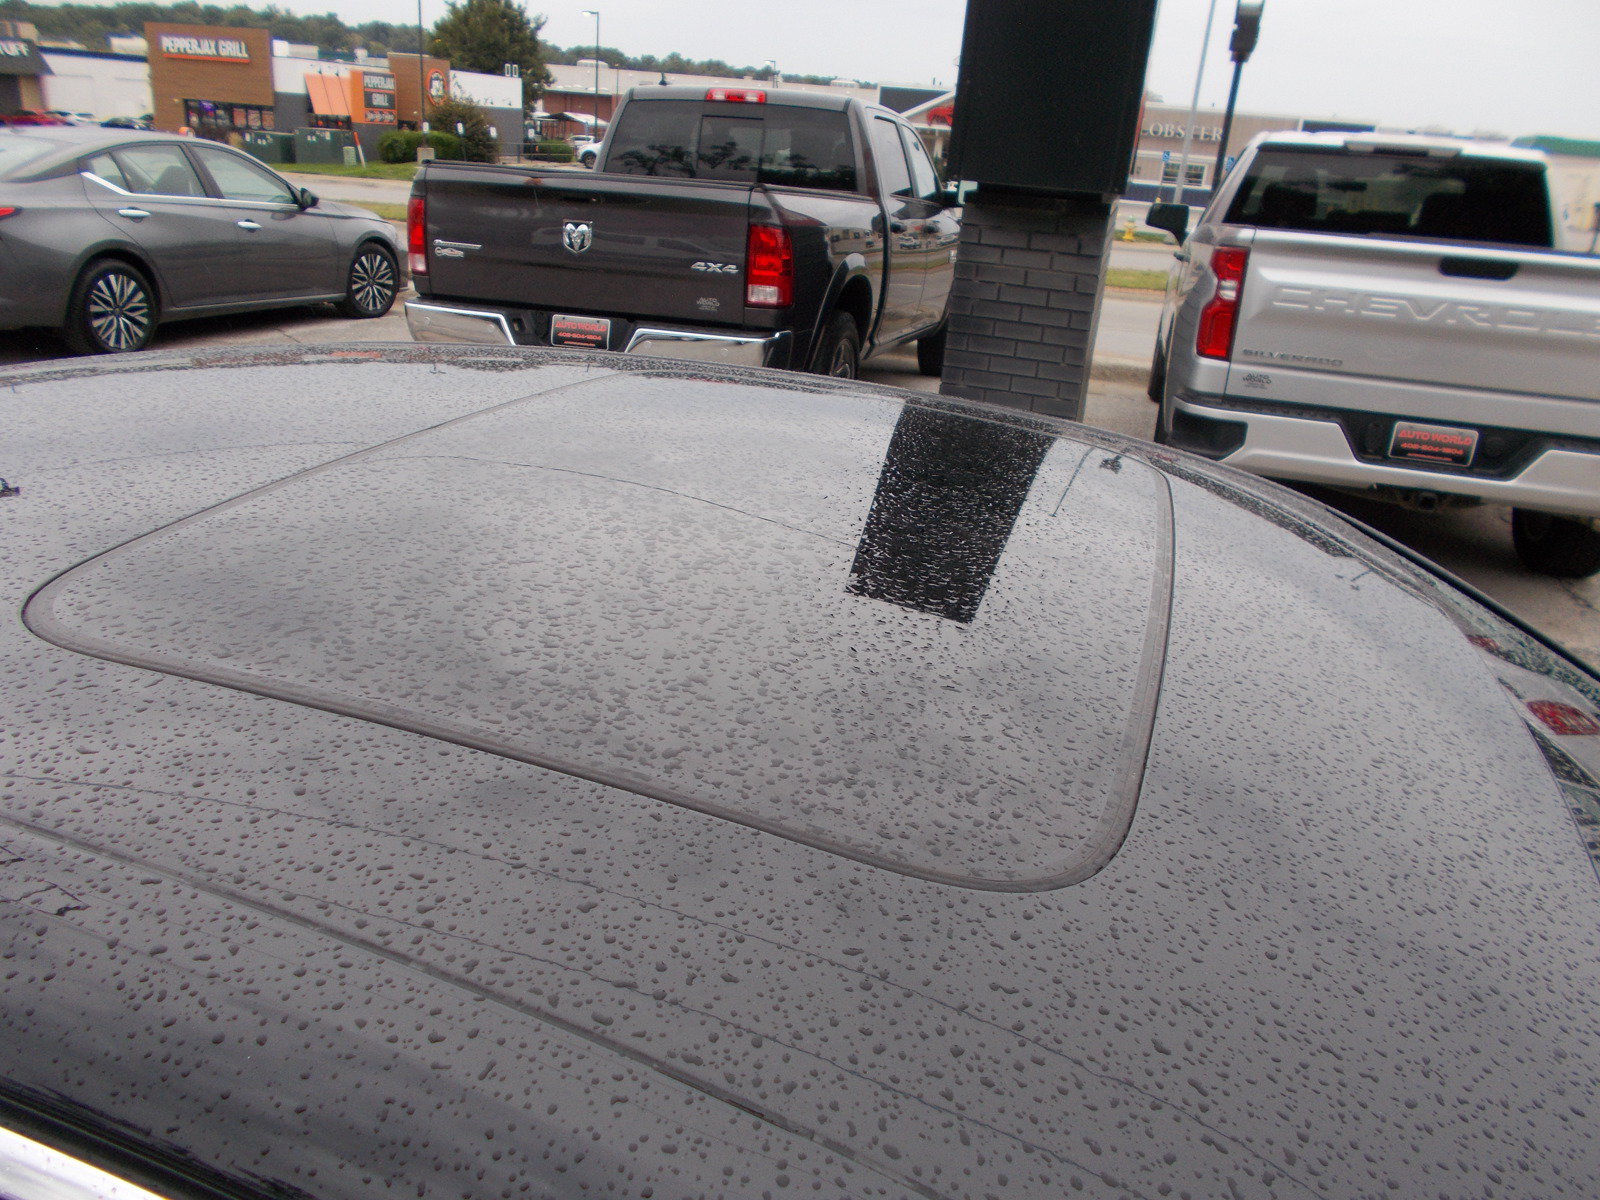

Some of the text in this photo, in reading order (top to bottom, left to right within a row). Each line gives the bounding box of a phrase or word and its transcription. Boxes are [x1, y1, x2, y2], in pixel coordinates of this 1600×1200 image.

[161, 36, 249, 57] PEPPERJAX GRILL
[363, 75, 395, 89] PEPPERJAX
[555, 321, 607, 332] AUTO WORLD
[1242, 349, 1343, 366] SILVERADO
[1242, 376, 1272, 384] WORLD
[1399, 429, 1473, 446] AUTO WORLD
